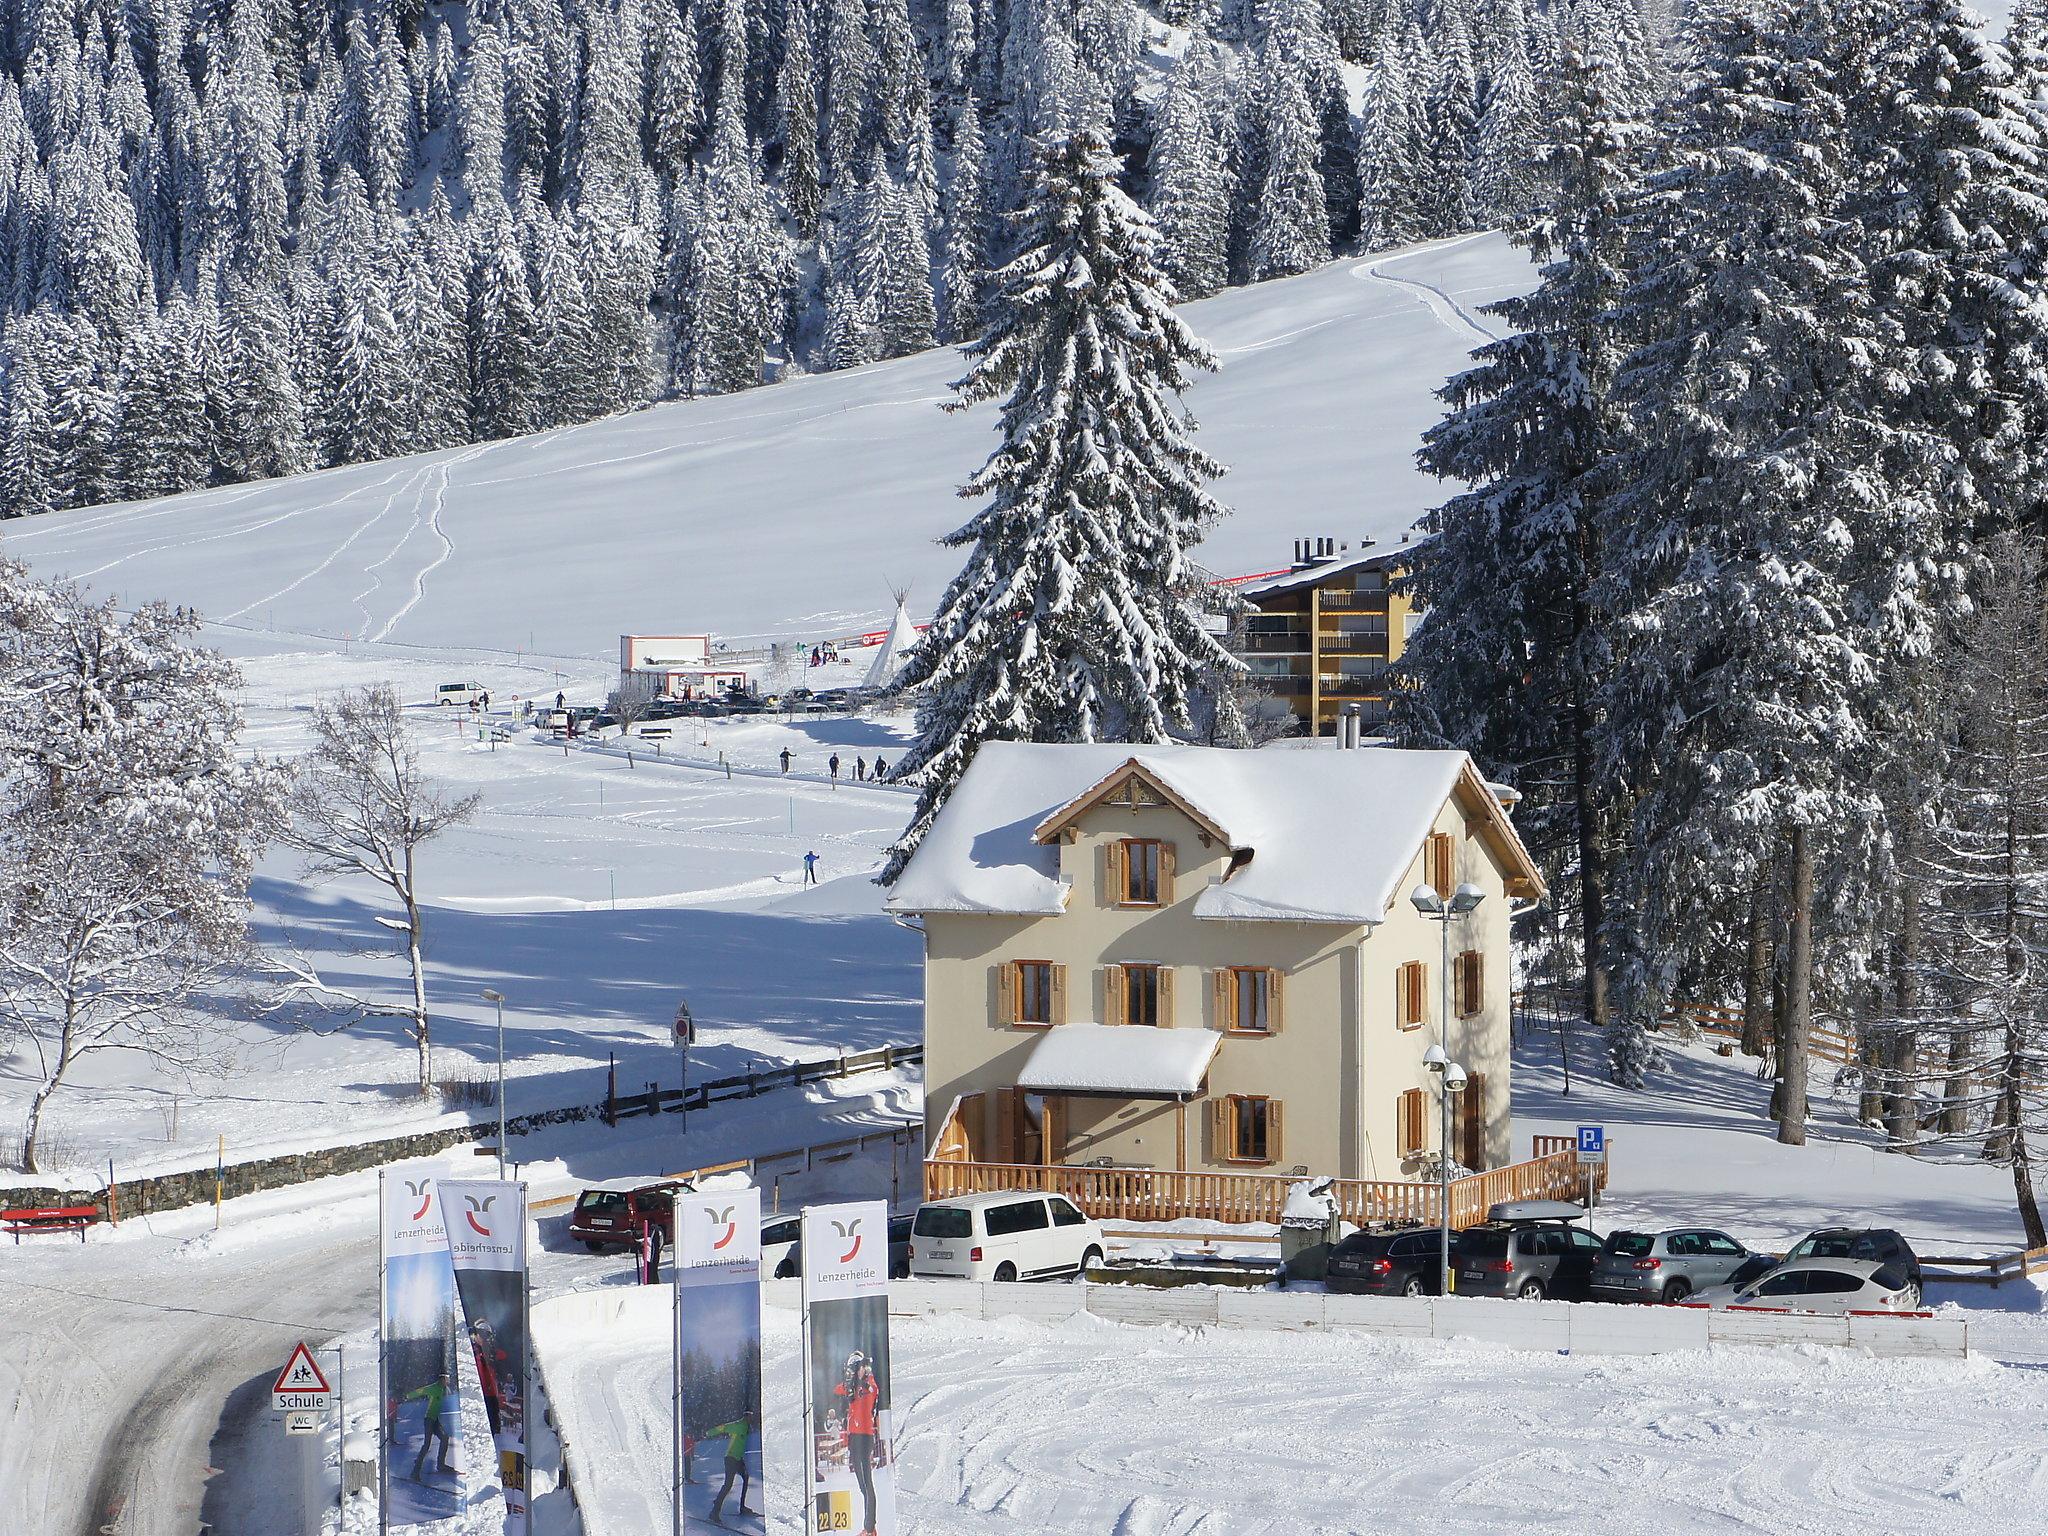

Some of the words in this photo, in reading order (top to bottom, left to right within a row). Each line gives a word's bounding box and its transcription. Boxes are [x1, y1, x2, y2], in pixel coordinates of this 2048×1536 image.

[1582, 1129, 1595, 1148] P
[394, 1225, 445, 1239] Lenzerheide
[691, 1254, 750, 1268] Lenzerheide
[817, 1268, 876, 1283] Lenzerheide
[279, 1394, 324, 1408] Schule
[294, 1416, 310, 1425] WC
[818, 1512, 830, 1530] 22
[834, 1511, 848, 1528] 23
